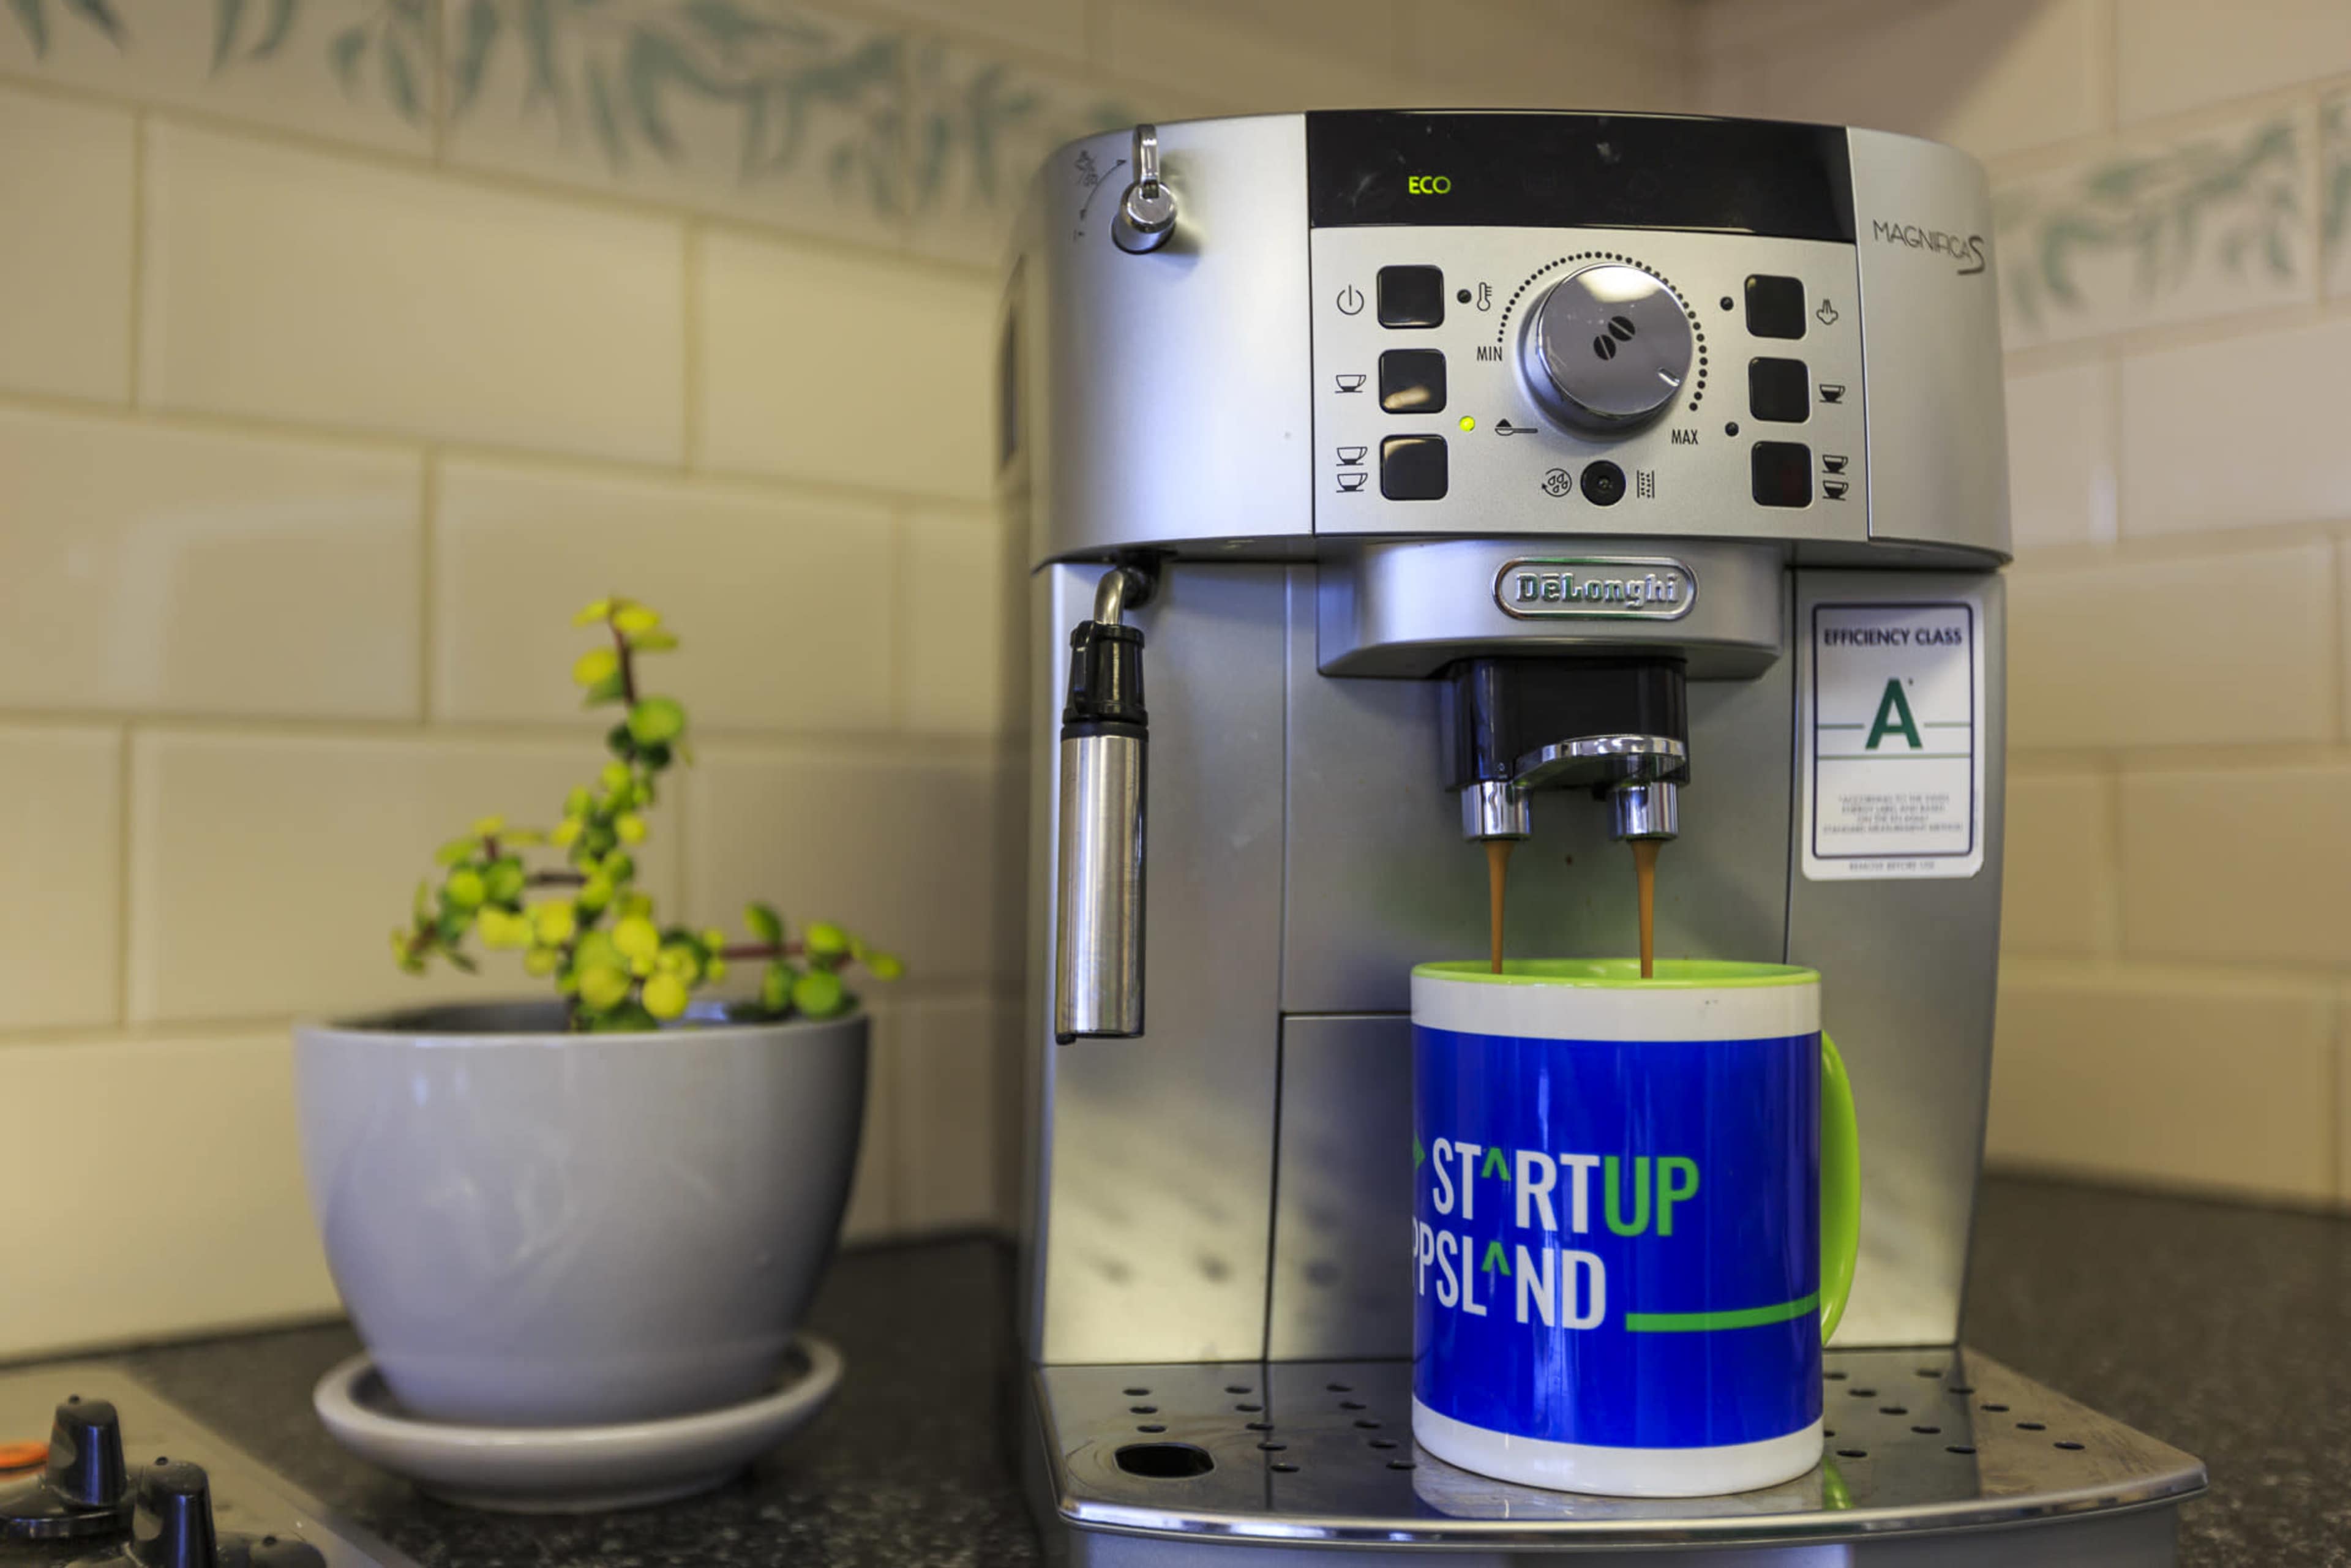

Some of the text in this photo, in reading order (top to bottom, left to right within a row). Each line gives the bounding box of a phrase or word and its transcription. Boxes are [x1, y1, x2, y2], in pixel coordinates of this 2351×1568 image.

[1409, 176, 1451, 194] ECO
[1477, 346, 1502, 361] MIN
[1671, 429, 1698, 445] MAX
[1824, 628, 1962, 646] EFFICIENCY CLASS
